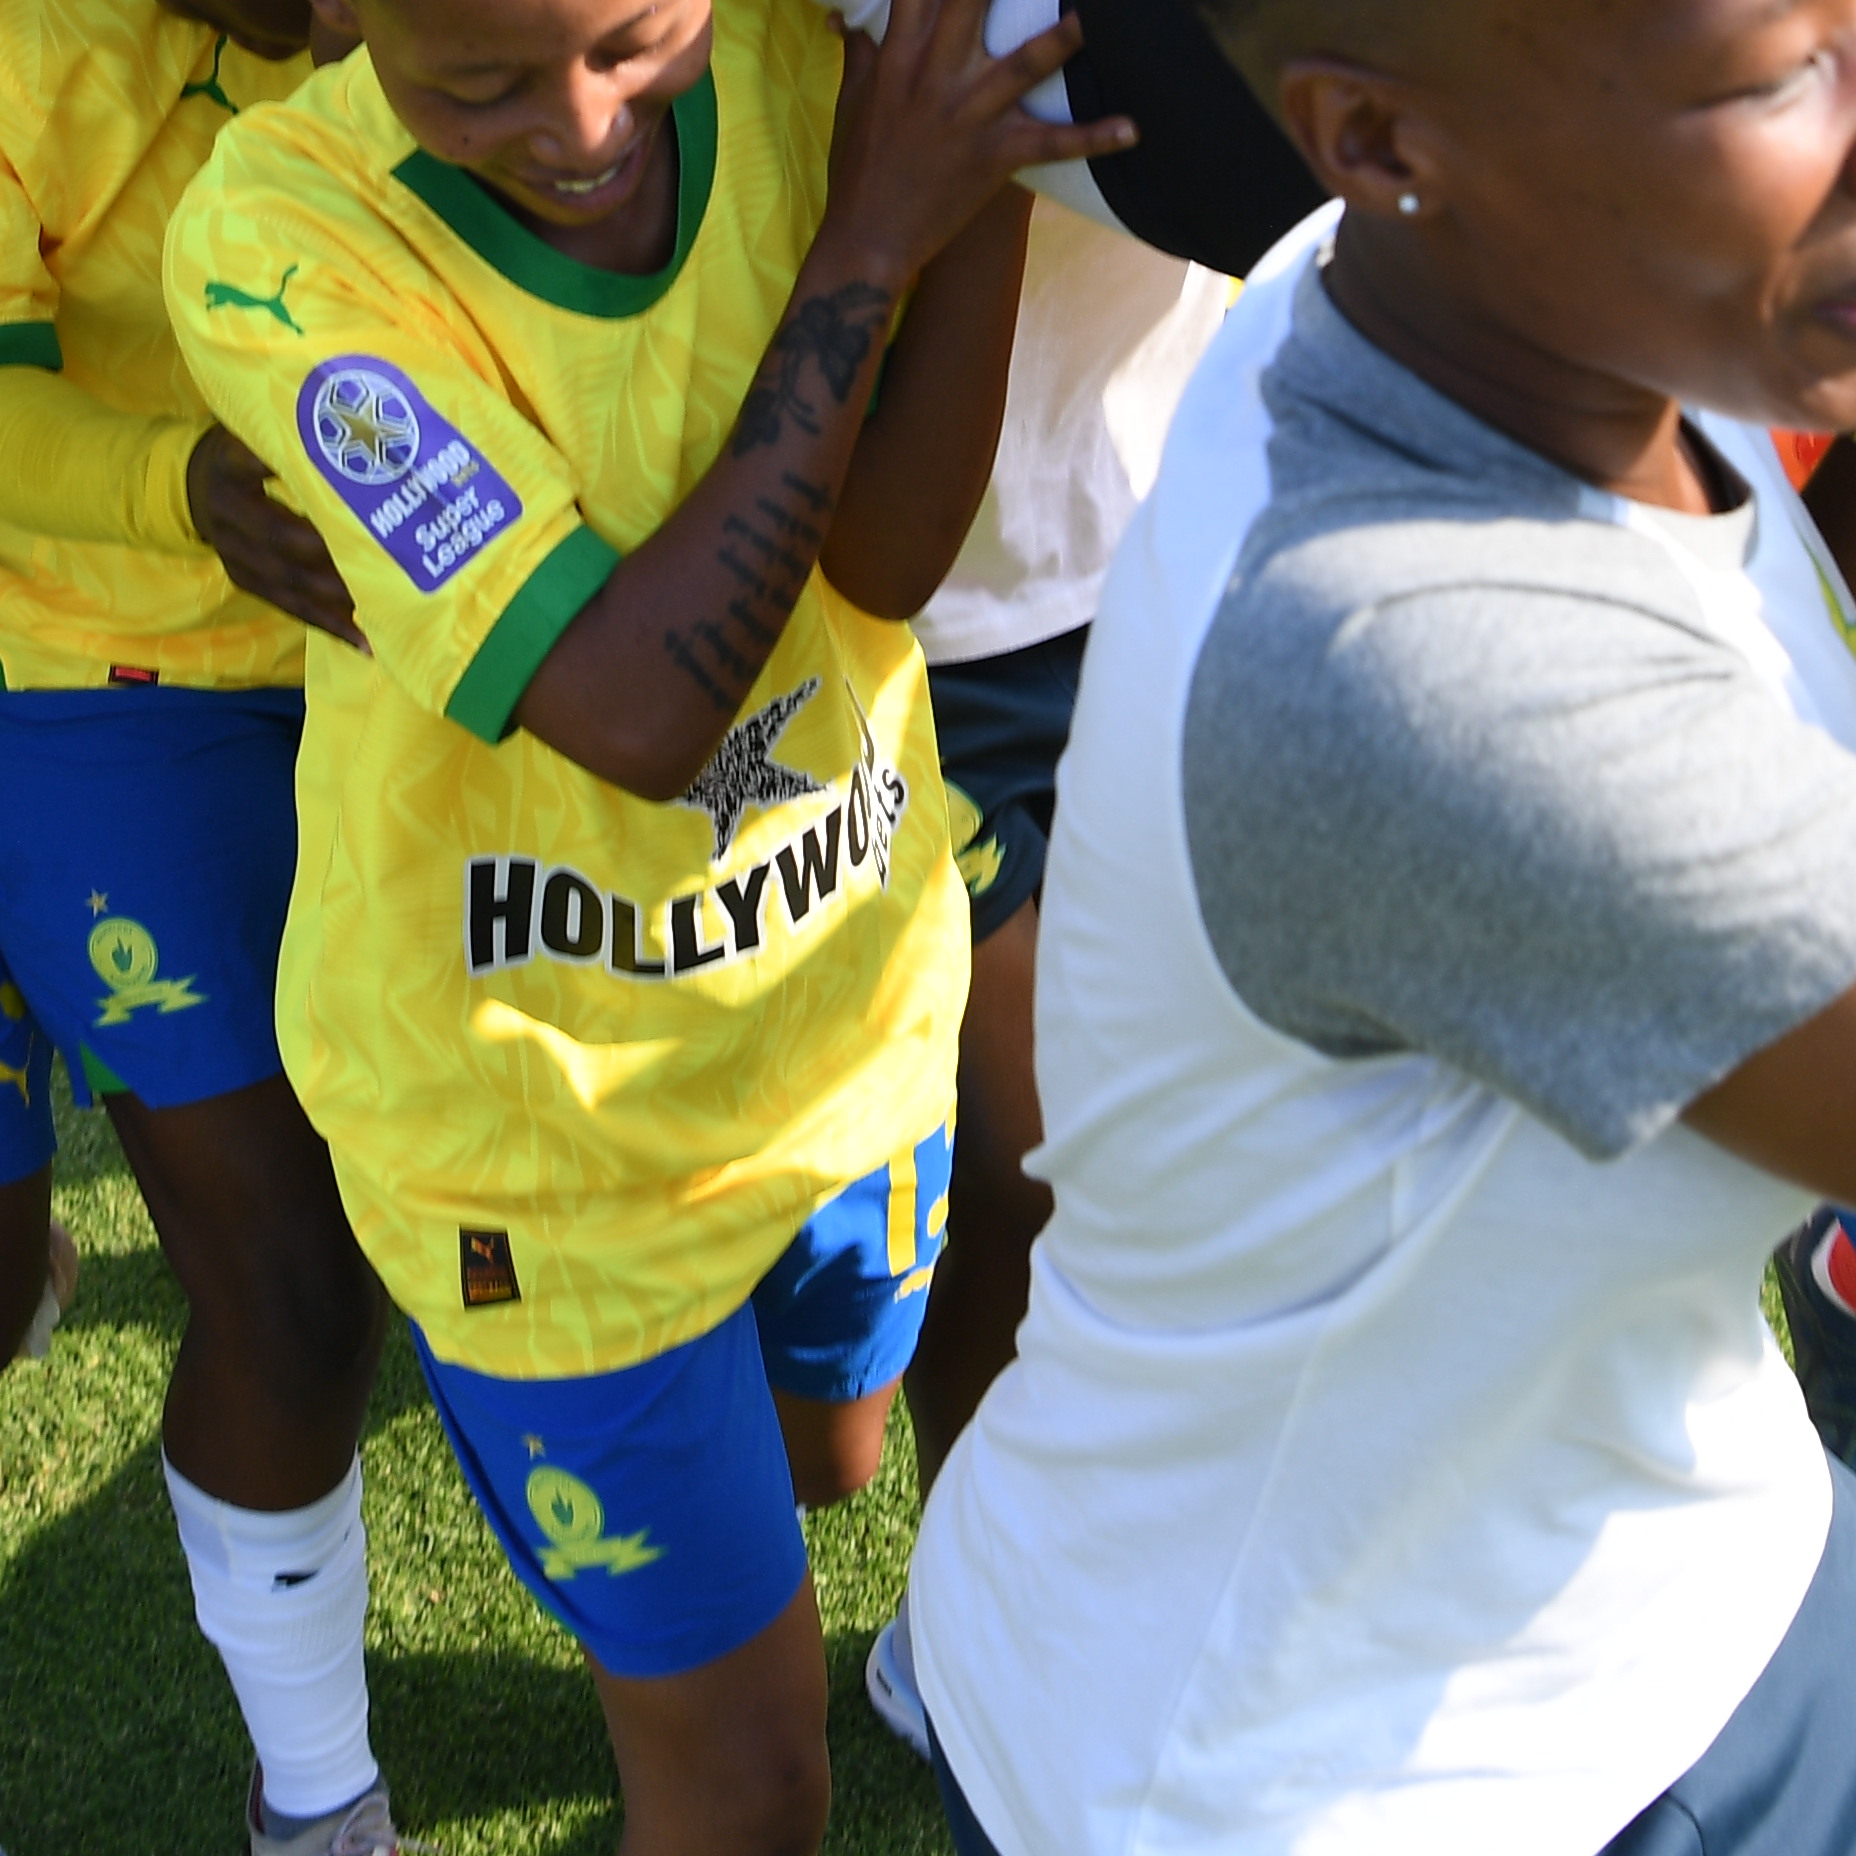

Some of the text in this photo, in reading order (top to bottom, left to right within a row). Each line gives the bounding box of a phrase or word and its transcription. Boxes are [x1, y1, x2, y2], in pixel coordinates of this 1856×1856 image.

[370, 440, 471, 539] HOLLYWOOD
[415, 485, 479, 552] Super
[422, 499, 505, 578] League
